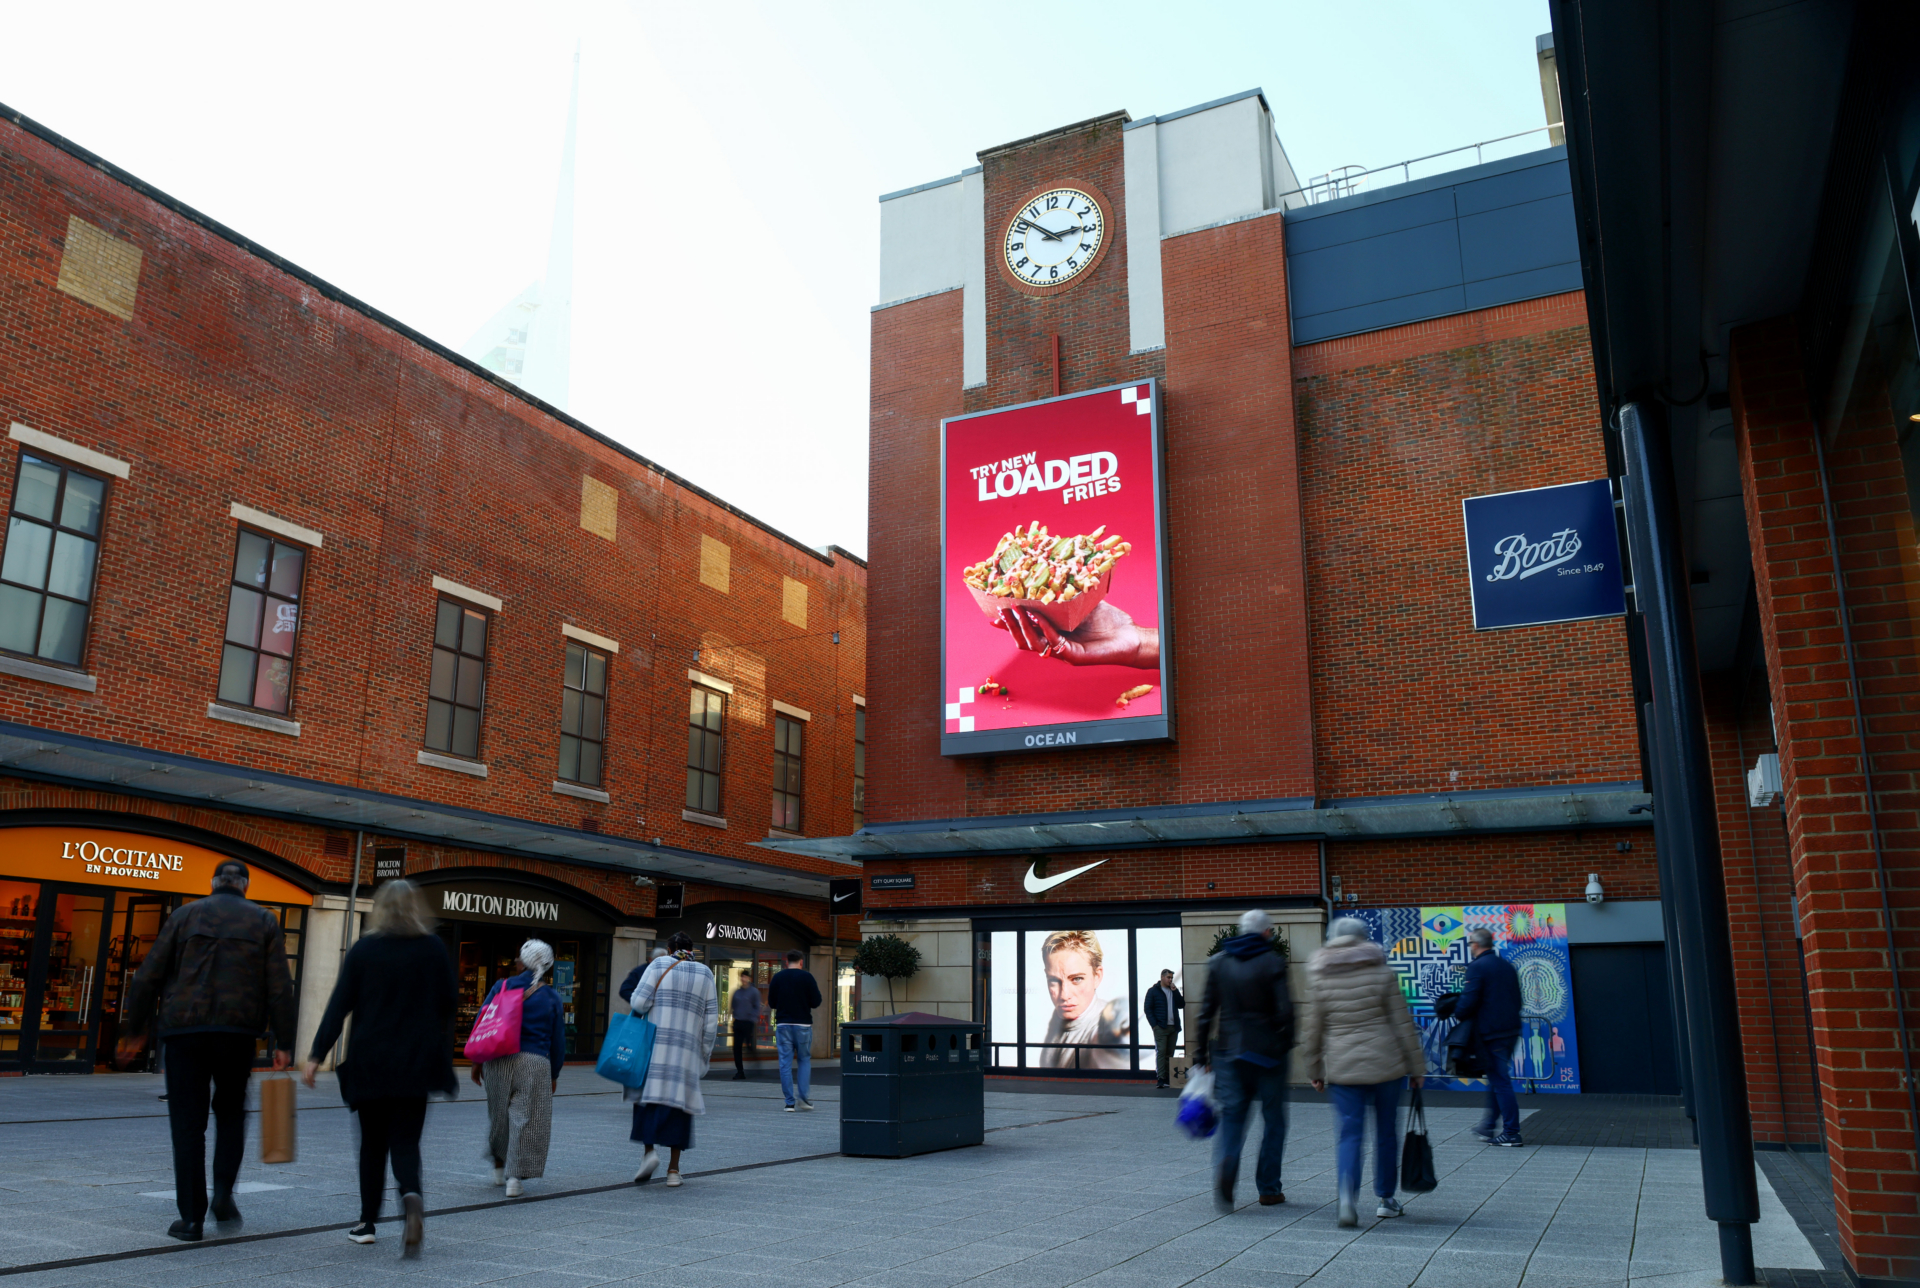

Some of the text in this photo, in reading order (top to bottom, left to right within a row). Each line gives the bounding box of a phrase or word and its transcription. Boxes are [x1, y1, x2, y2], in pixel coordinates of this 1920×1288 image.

[1046, 196, 1058, 210] 12
[1067, 196, 1075, 209] 1
[1029, 206, 1041, 218] 11
[1077, 205, 1091, 219] 2
[1014, 221, 1029, 235] 10
[1083, 223, 1096, 233] 3
[1011, 242, 1024, 251] 9
[1080, 243, 1092, 252] 4
[1016, 256, 1029, 269] 8
[1067, 256, 1078, 269] 5
[1031, 265, 1042, 278] 7
[1050, 266, 1058, 279] 6
[970, 451, 1037, 480] TRY NEW
[978, 451, 1118, 502] LOADED
[1062, 476, 1122, 505] FRIES
[1486, 527, 1582, 582] Boots
[1557, 563, 1605, 577] Since 1849
[1024, 731, 1077, 747] OCEAN
[377, 860, 401, 869] MOLTON
[85, 864, 160, 880] EN PROVENCE
[376, 869, 400, 877] BROWN
[442, 890, 559, 922] MOLTON BROWN
[718, 924, 767, 942] SWAROVSKI
[855, 1054, 876, 1063] Litter
[1560, 1067, 1573, 1075] HS
[1560, 1074, 1574, 1082] DC
